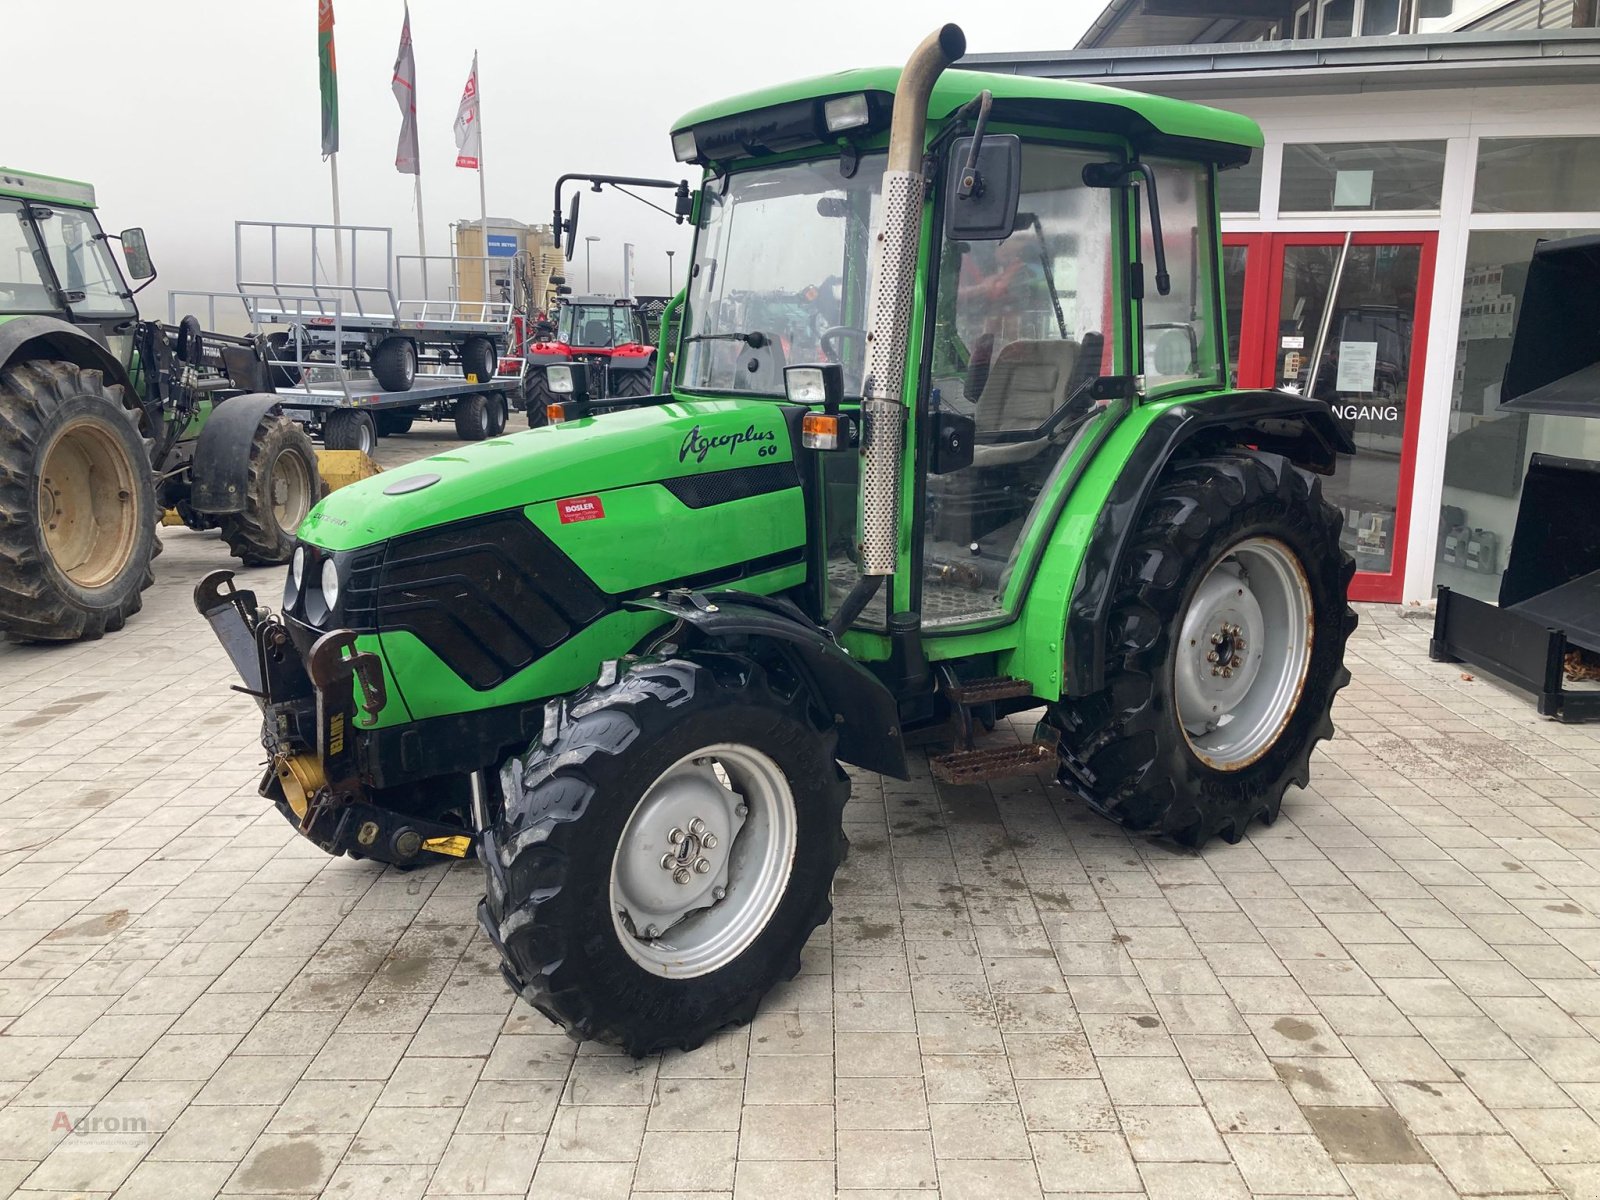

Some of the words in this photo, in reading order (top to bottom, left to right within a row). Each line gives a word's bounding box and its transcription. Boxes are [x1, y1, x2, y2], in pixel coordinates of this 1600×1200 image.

[1331, 405, 1398, 421] NGANG
[679, 424, 775, 463] Agroplus
[758, 444, 778, 457] 60
[565, 502, 595, 514] BOSLER
